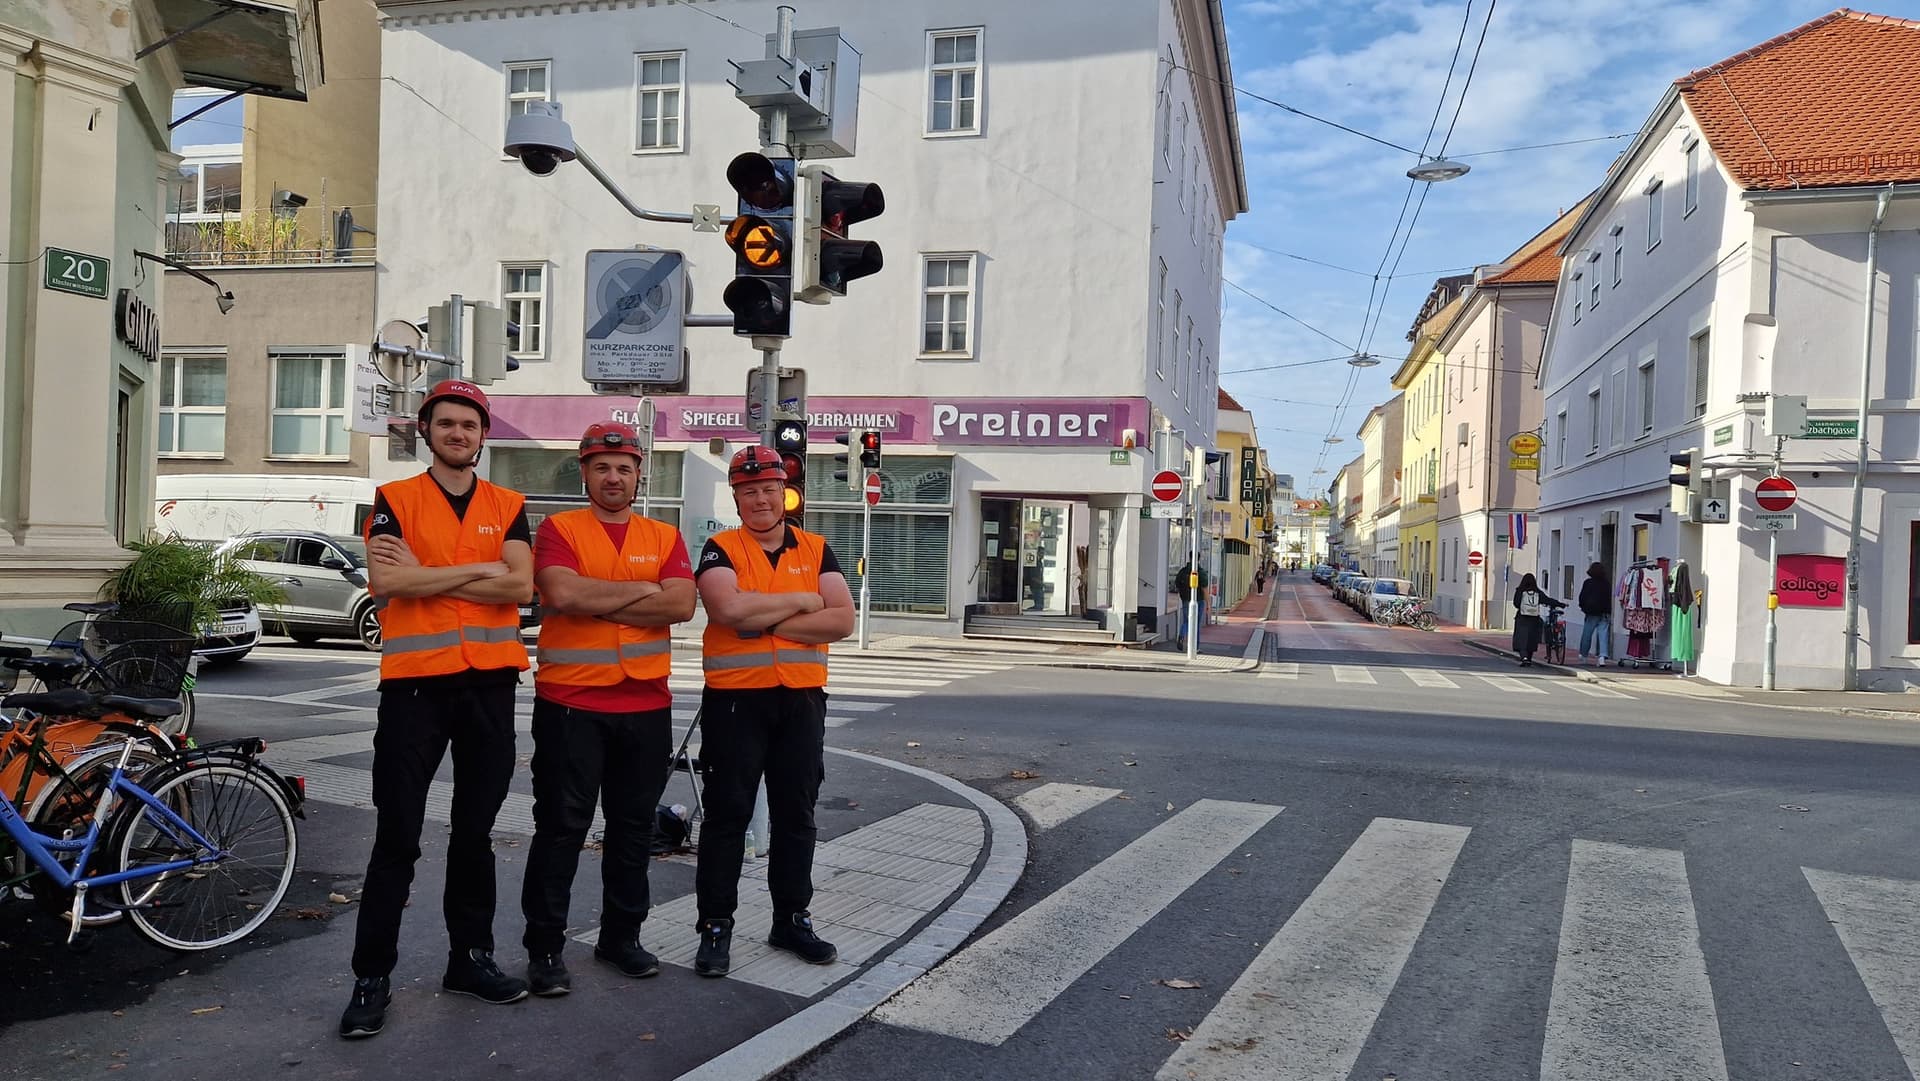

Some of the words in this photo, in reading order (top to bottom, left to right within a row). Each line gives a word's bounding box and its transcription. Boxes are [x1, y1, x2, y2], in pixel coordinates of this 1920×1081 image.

[62, 255, 95, 282] 20
[590, 343, 675, 352] KURZPARKZONE
[357, 363, 381, 376] Prein
[611, 409, 640, 425] GLA
[682, 410, 744, 426] SPIEGEL
[807, 412, 895, 428] DERRAHMEN
[933, 404, 1108, 437] Preiner
[1807, 426, 1856, 436] zbachgasse
[1114, 452, 1125, 460] 18
[1780, 577, 1839, 599] collage
